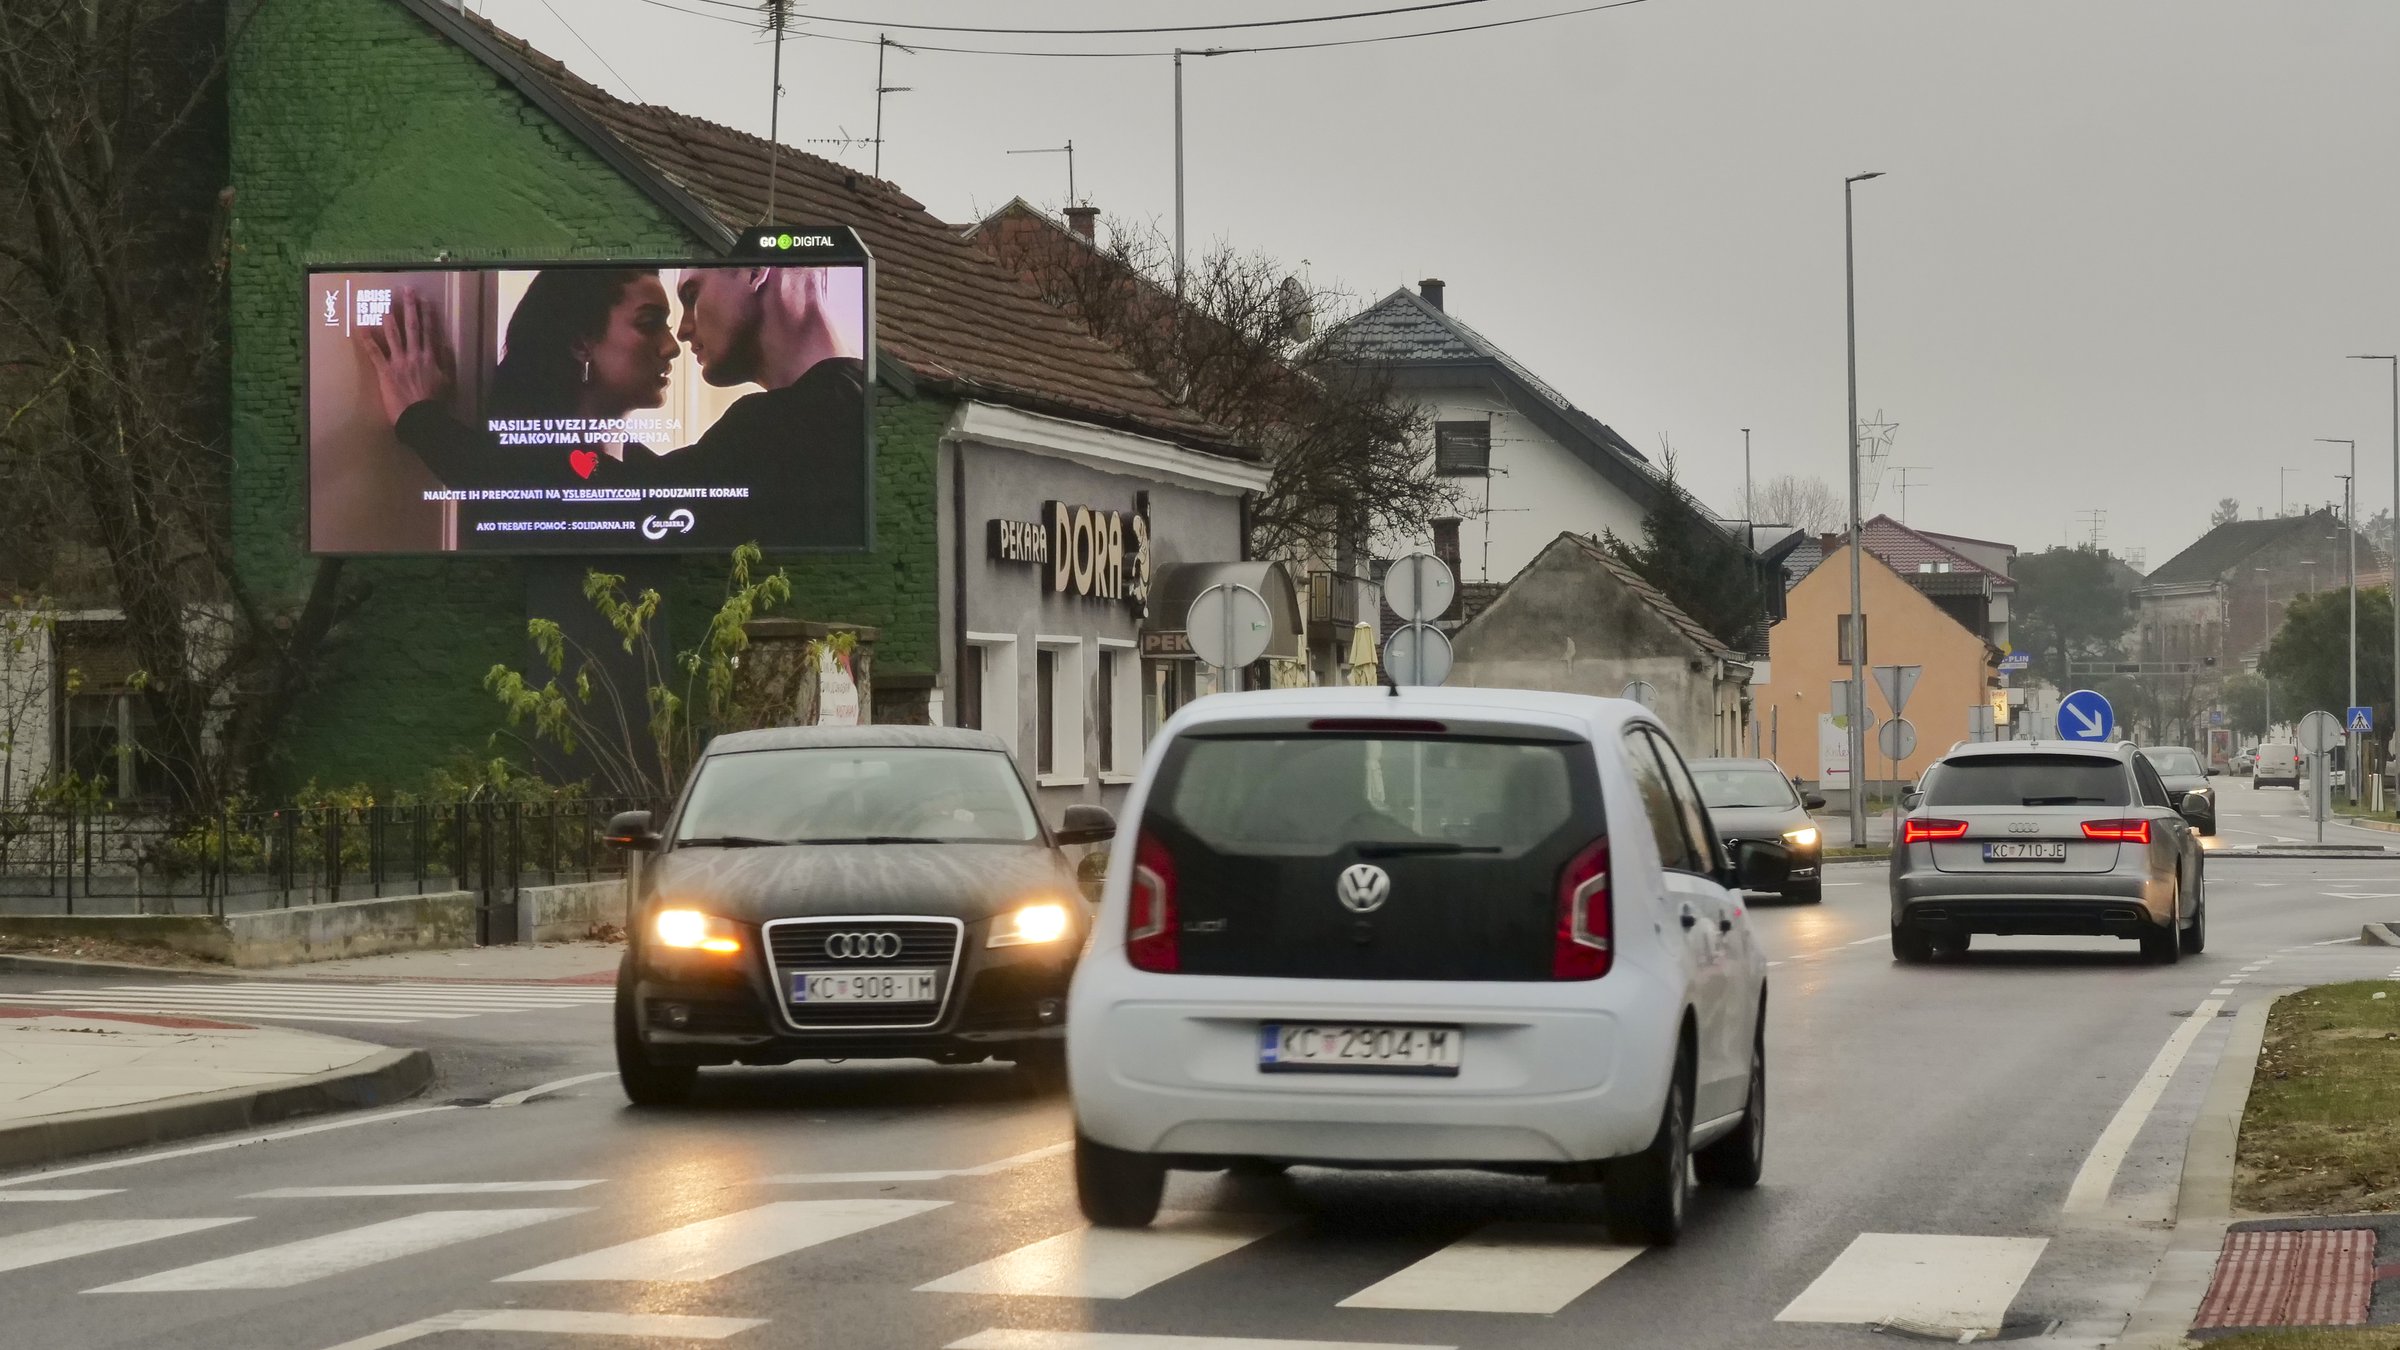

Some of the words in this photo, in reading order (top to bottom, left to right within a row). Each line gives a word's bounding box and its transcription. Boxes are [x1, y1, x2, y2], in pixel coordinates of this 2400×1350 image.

[793, 236, 835, 247] DIGITAL
[356, 289, 392, 302] ABUSE
[356, 302, 369, 314] IS
[369, 302, 391, 314] NOT
[356, 314, 383, 326] LOVE
[489, 420, 541, 432] NASILJE
[544, 420, 553, 431] U
[555, 420, 586, 431] VEZI
[589, 418, 662, 431] ZAPOČINJE
[666, 419, 682, 430] SA
[499, 433, 581, 445] ZNAKOVIMA
[584, 432, 671, 444] UPOZORENJA
[424, 489, 467, 500] NAUČITE
[469, 490, 480, 500] IH
[482, 490, 543, 500] PREPOZNATI
[545, 489, 561, 499] NA
[562, 489, 641, 500] YSLBEAUTY.COM
[642, 489, 646, 498] I
[649, 488, 708, 498] PODUZMITE
[709, 488, 749, 498] KORAKE
[476, 522, 496, 531] AKO
[498, 522, 533, 531] TREBATE
[1000, 519, 1048, 564] PEKARA
[1055, 501, 1122, 600] DORA
[1993, 844, 2008, 857] KC
[2018, 844, 2063, 857] 710-JE
[810, 976, 834, 999] KC
[1284, 1028, 1317, 1058] KC
